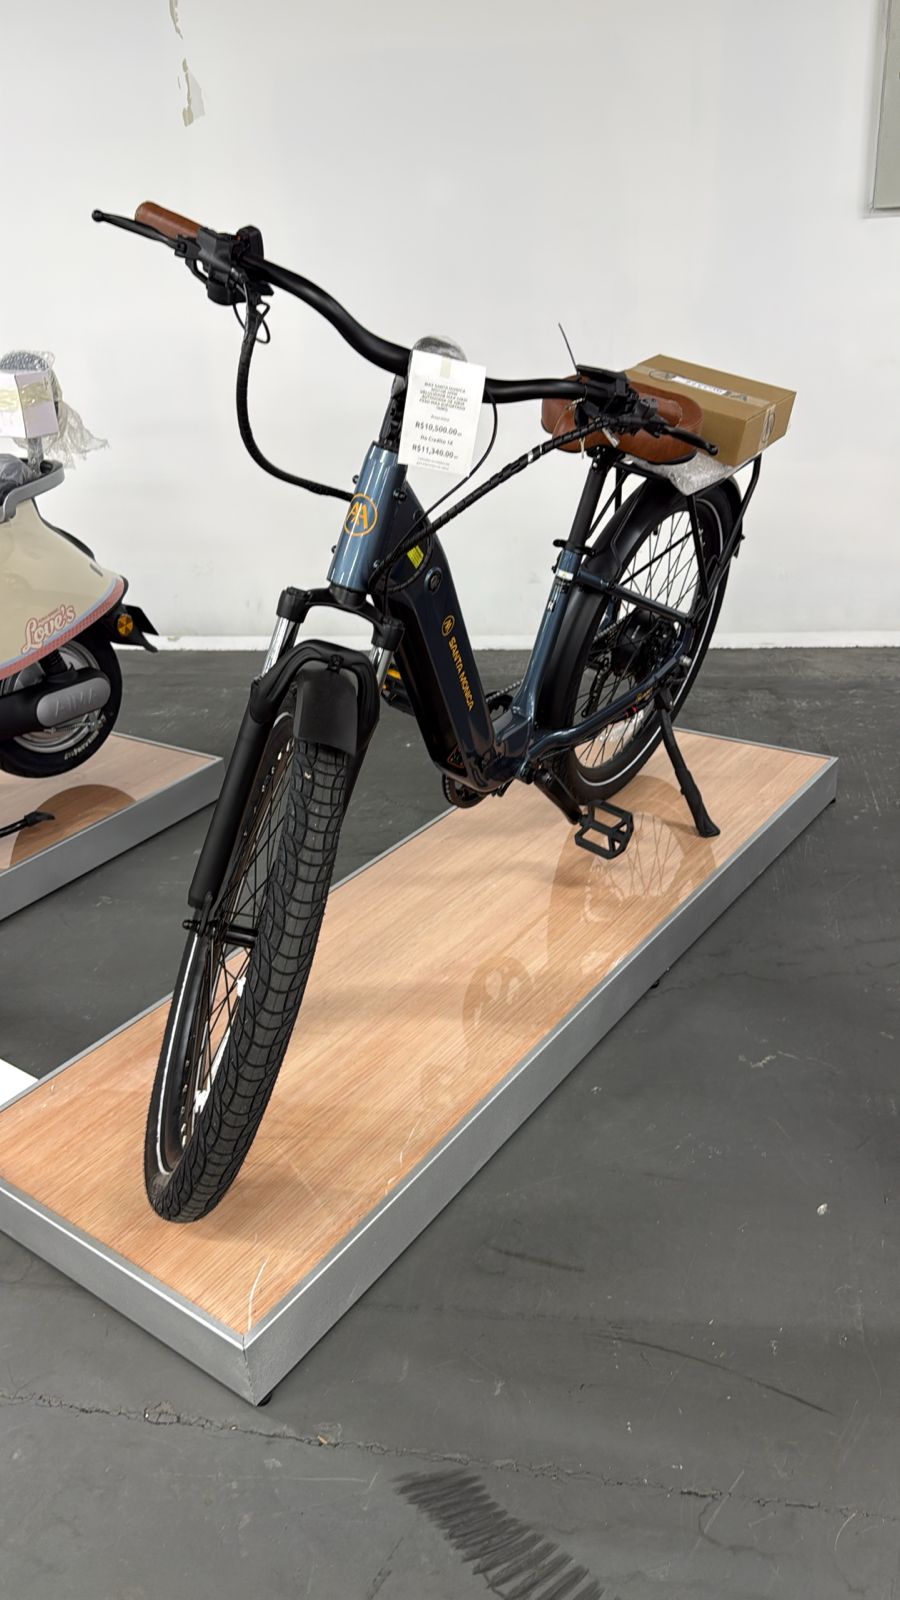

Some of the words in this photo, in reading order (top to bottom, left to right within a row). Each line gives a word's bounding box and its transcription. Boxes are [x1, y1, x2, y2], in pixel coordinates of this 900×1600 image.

[21, 604, 75, 653] Love's
[449, 636, 463, 673] SANTA
[459, 671, 474, 711] MONICA
